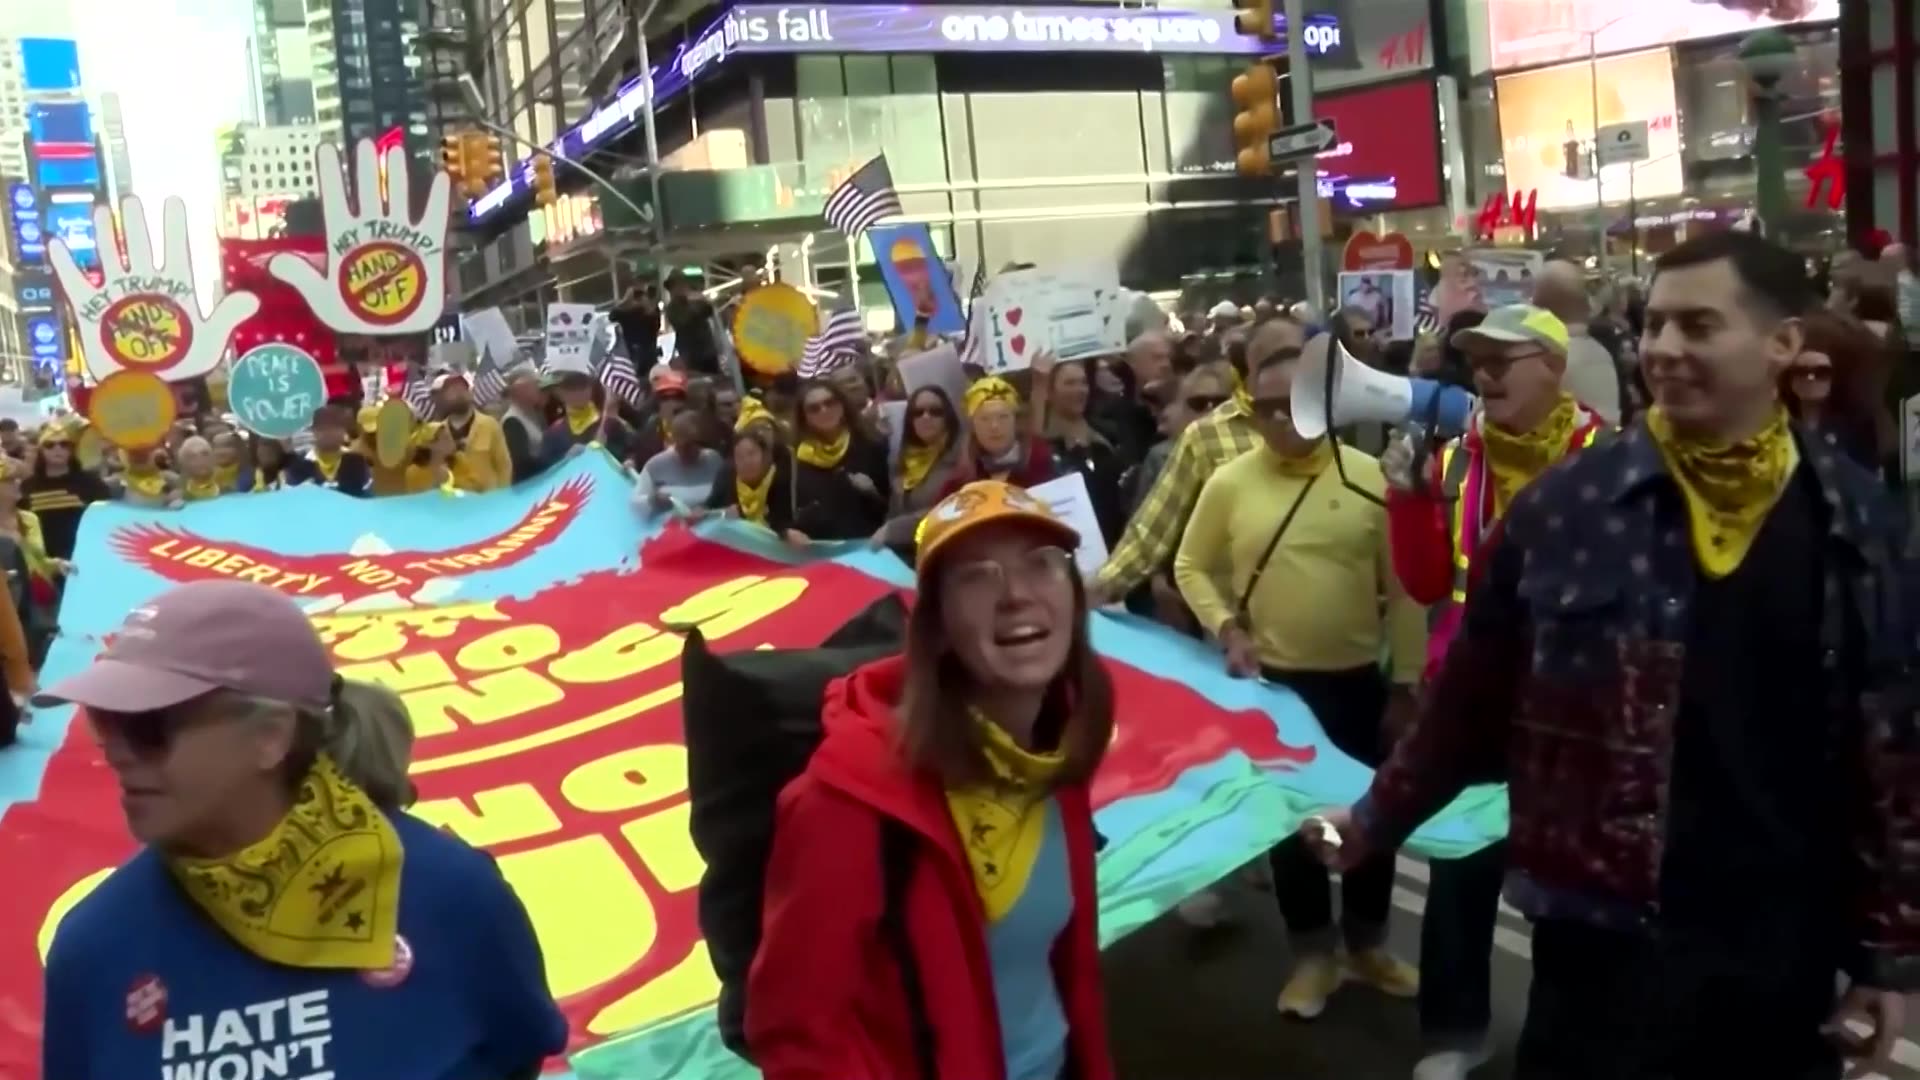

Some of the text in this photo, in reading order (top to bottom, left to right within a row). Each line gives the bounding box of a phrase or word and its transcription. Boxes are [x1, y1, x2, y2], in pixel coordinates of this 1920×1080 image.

[723, 9, 769, 47] this
[777, 8, 834, 41] fall
[941, 10, 1220, 52] one times square
[1479, 188, 1538, 241] HM
[333, 219, 443, 256] HEY TRUMP!
[79, 289, 113, 322] HEY
[361, 276, 409, 308] OFF
[130, 327, 170, 359] OFF
[246, 352, 301, 379] PEACE
[268, 374, 290, 393] IS
[242, 391, 312, 422] POWER
[149, 500, 570, 593] LIBERTY NOT TYRANNY
[334, 623, 561, 693] NO
[404, 575, 809, 738] NGS
[404, 743, 691, 848] NO
[162, 989, 332, 1060] HATE
